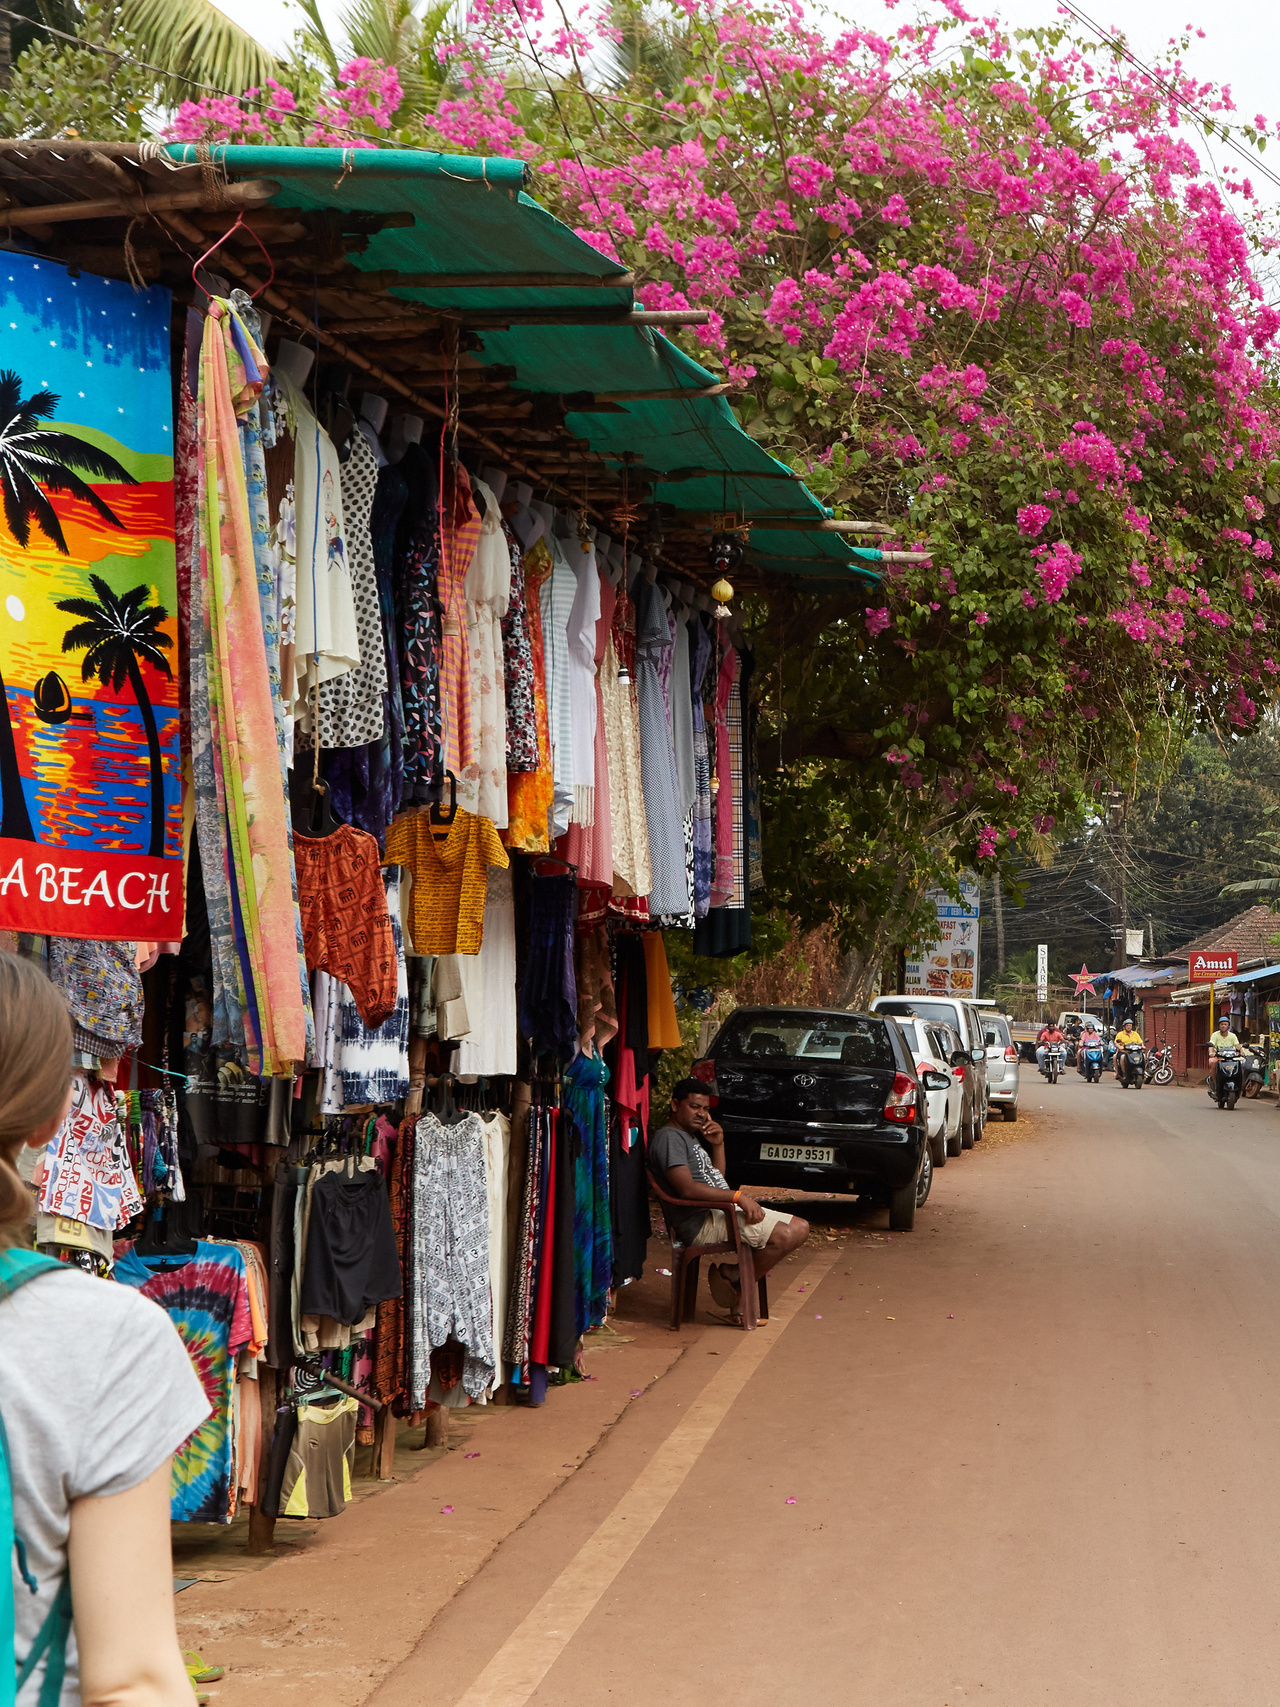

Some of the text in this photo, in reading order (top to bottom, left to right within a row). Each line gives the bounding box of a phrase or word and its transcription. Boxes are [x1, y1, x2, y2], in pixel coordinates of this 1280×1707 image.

[36, 863, 170, 914] BEACH
[1194, 956, 1233, 970] Amul
[767, 1146, 780, 1158] GA
[782, 1147, 796, 1159] 03
[796, 1148, 803, 1160] P
[805, 1148, 831, 1161] 9531
